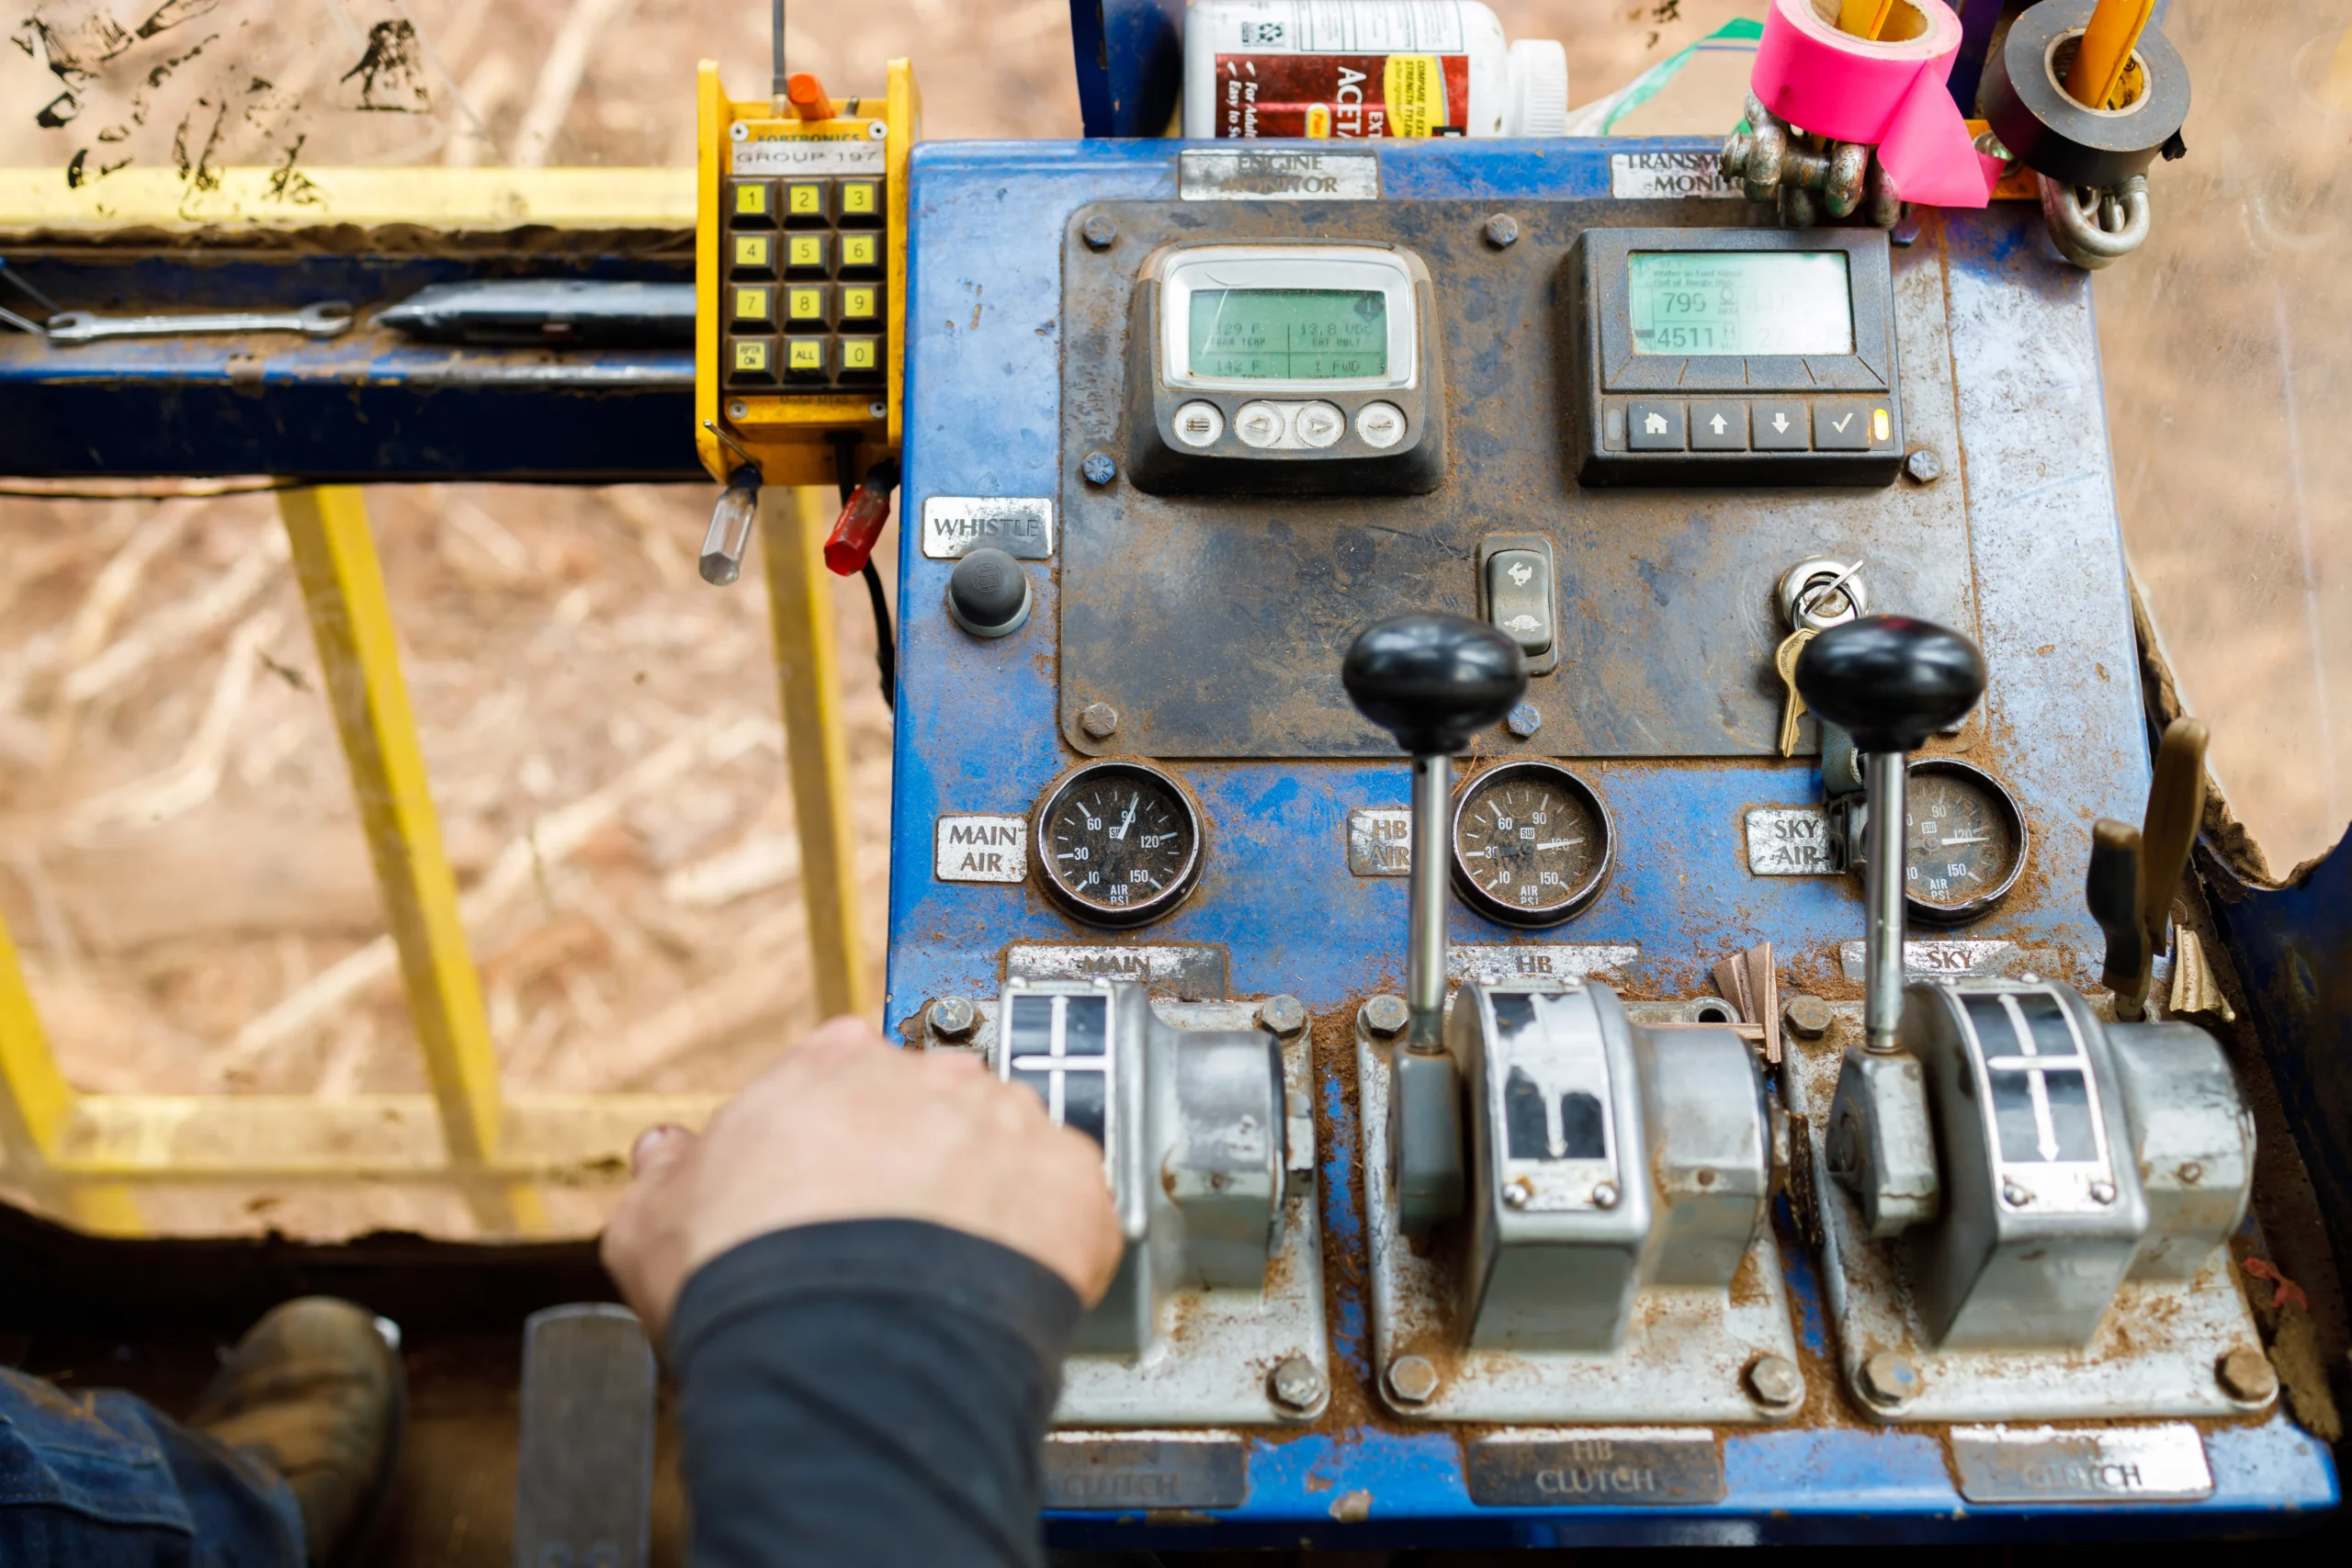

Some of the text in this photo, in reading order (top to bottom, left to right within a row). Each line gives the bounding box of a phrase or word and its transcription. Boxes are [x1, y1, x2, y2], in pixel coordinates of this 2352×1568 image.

[1405, 60, 1414, 106] STRENGTH
[1416, 60, 1426, 103] COMPARE
[1225, 80, 1242, 108] Easy
[1244, 81, 1259, 103] For
[1227, 109, 1241, 124] to
[1416, 106, 1425, 117] TO
[737, 152, 878, 163] GROUP 197
[1239, 154, 1324, 171] ENGINE
[1220, 175, 1338, 193] MONITOR
[748, 191, 755, 207] 1
[799, 191, 809, 208] 2
[854, 190, 864, 207] 3
[746, 243, 756, 257] 4
[800, 243, 810, 258] 5
[853, 243, 864, 258] 6
[746, 296, 756, 310] 7
[799, 296, 810, 311] 8
[854, 295, 865, 310] 9
[1657, 327, 1713, 348] 4511
[743, 356, 756, 366] ON
[795, 351, 814, 360] ALL
[854, 347, 865, 362] 0
[1217, 360, 1260, 373] 142 F
[1332, 359, 1360, 372] FWD
[933, 518, 1039, 536] WHISTLE
[1532, 811, 1547, 825] 90
[1931, 805, 1947, 818] 90
[1087, 818, 1102, 830] 60
[1372, 819, 1408, 840] HB
[1498, 817, 1513, 830] 60
[1774, 819, 1819, 839] SKY
[948, 825, 1017, 846] MAIN
[1521, 829, 1534, 838] SW
[1140, 835, 1159, 849] 120
[1074, 847, 1089, 861] 30
[1369, 845, 1411, 866] AIR
[1776, 845, 1821, 865] AIR
[960, 852, 1002, 873] AIR
[1947, 863, 1966, 877] 150
[1088, 871, 1100, 885] 10
[1130, 869, 1148, 883] 150
[1498, 870, 1510, 884] 10
[1540, 872, 1559, 885] 150
[1110, 884, 1128, 896] AIR
[1521, 885, 1538, 897] AIR
[1930, 878, 1948, 890] AIR
[1110, 896, 1129, 906] PSI
[1930, 889, 1950, 900] PSI
[1080, 954, 1151, 975] MAIN
[1515, 955, 1554, 974] HB
[1926, 950, 1973, 969] SKY
[1573, 1439, 1614, 1461] HB
[1535, 1469, 1655, 1495] CLUTCH
